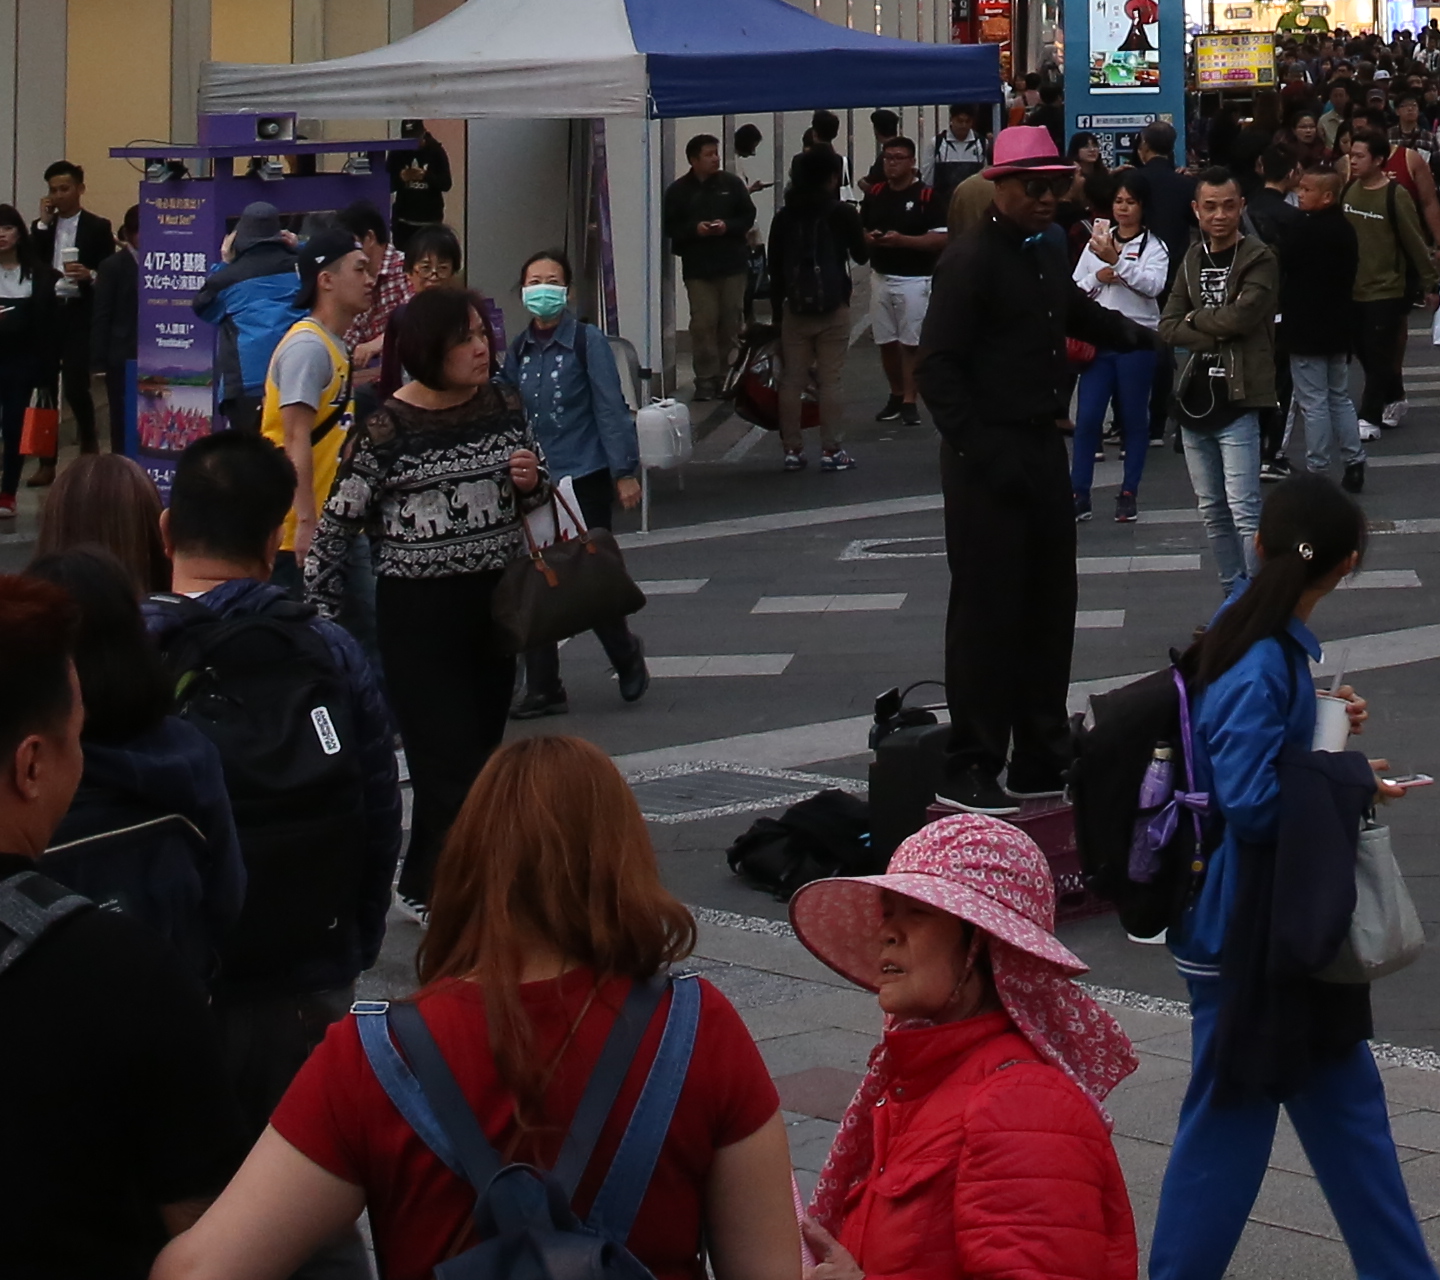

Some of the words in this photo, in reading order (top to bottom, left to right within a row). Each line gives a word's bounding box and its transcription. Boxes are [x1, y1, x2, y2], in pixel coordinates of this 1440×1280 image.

[1343, 203, 1384, 219] Champion
[144, 252, 181, 271] 4/17-18
[183, 252, 206, 272] 基隆
